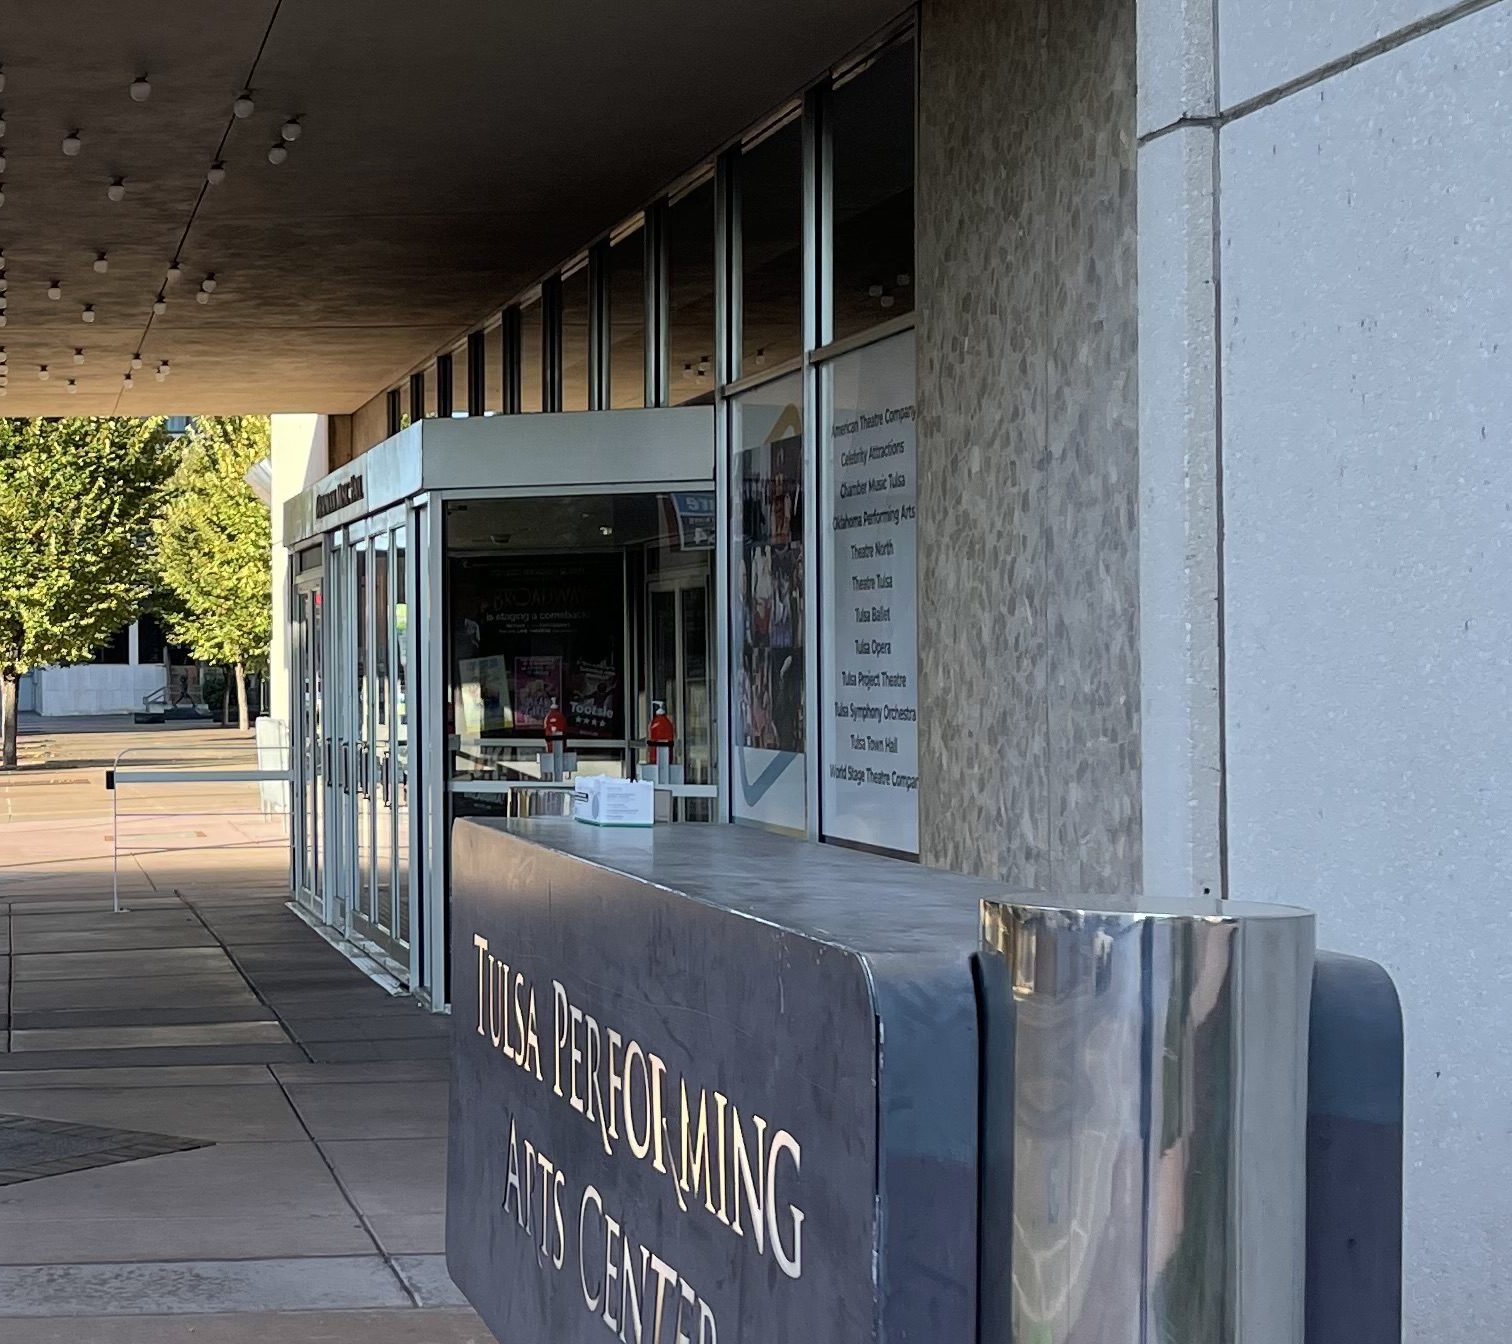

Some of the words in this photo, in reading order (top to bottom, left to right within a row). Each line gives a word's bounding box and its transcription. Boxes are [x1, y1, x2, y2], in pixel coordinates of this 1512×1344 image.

[831, 420, 859, 438] American
[860, 414, 884, 430] Theatre
[885, 405, 916, 424] Company
[841, 447, 867, 467] Celebrity
[868, 439, 904, 461] Attractions
[840, 480, 867, 499] Chamber
[868, 473, 887, 493] Music
[888, 472, 905, 488] Tulsa
[833, 513, 863, 530] Oklahoma
[863, 505, 899, 526] Performing
[900, 504, 915, 521] Arts
[850, 544, 874, 559] Theatre
[875, 539, 894, 556] North
[851, 576, 875, 591] Theatre
[876, 572, 893, 589] Tulsa
[854, 607, 870, 623] Tulsa
[872, 605, 891, 622] Ballet
[854, 639, 870, 655] Tulsa
[871, 639, 891, 658] Opera
[841, 670, 857, 686] Tulsa
[858, 670, 880, 691] Project
[881, 671, 906, 687] Theatre
[834, 701, 849, 717] Tulsa
[850, 702, 882, 724] Symphony
[883, 704, 917, 722] Orchestra
[850, 734, 866, 751] Tulsa
[867, 735, 884, 752] Town
[885, 737, 898, 753] Hall
[829, 763, 847, 780] World
[848, 765, 865, 785] Stage
[866, 767, 890, 785] Theatre
[473, 932, 543, 1083] TULSA
[551, 978, 805, 1280] PERFORMING
[502, 1112, 565, 1272] ARTS
